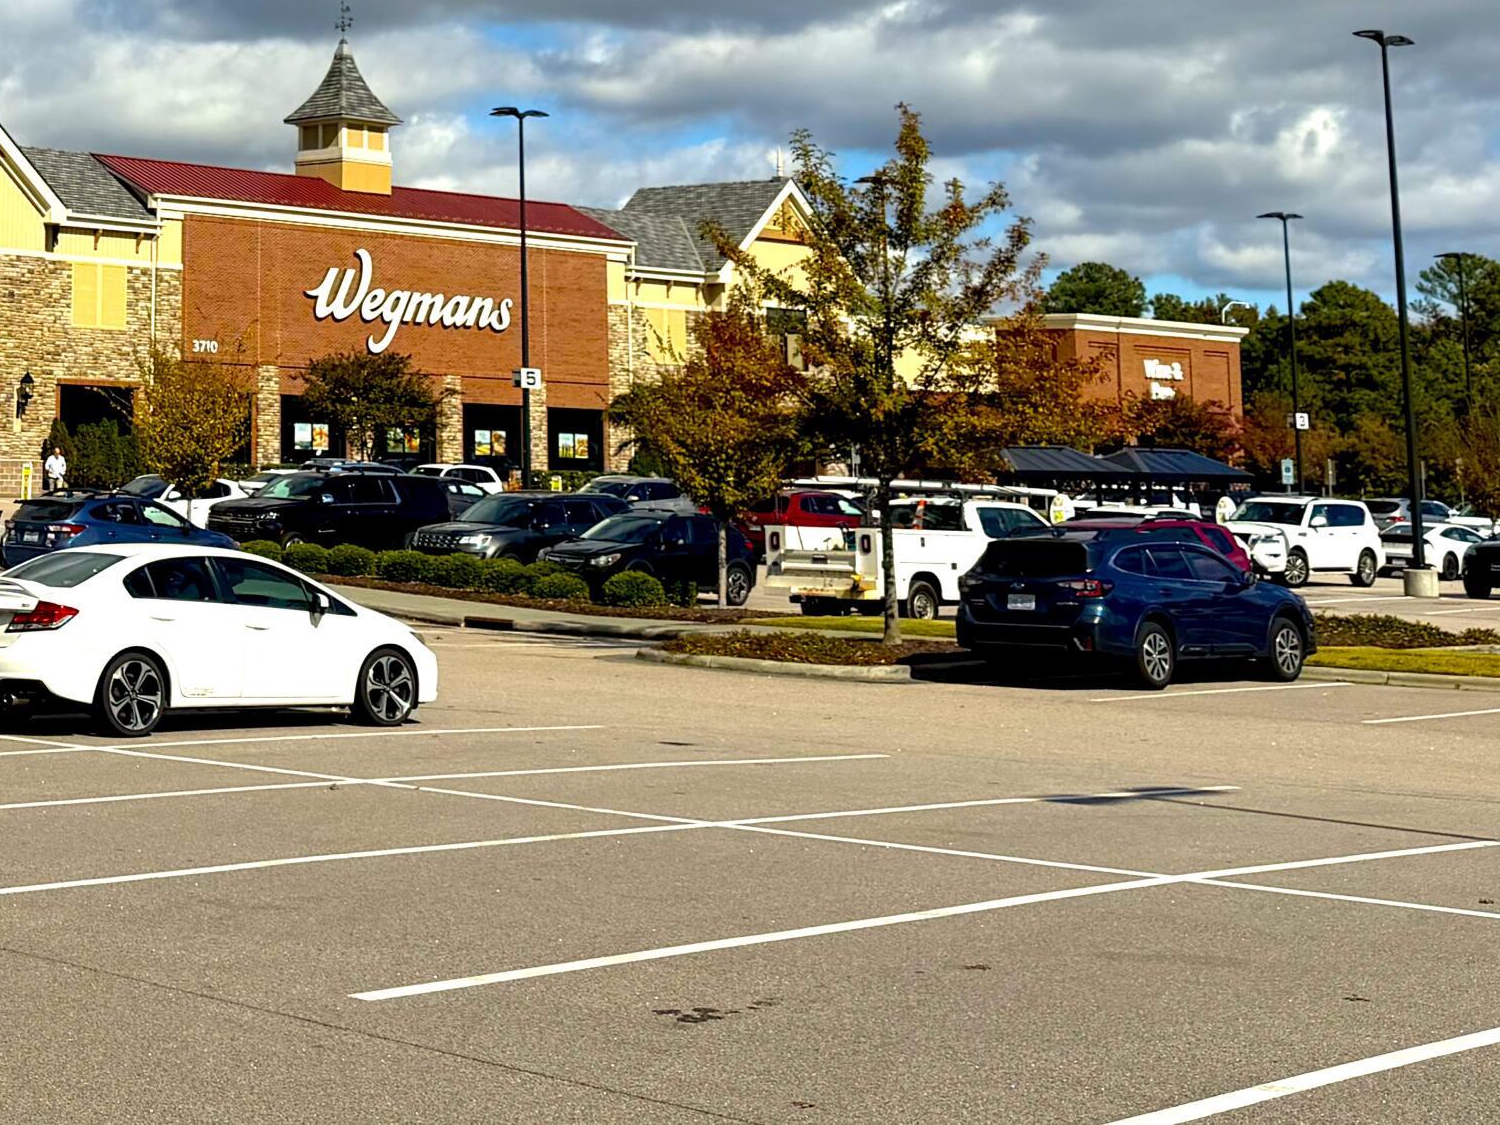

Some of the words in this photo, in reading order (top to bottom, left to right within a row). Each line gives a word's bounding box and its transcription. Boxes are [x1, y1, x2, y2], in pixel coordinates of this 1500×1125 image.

[303, 248, 514, 354] Wegmans
[192, 339, 219, 354] 3710
[526, 371, 536, 386] 5
